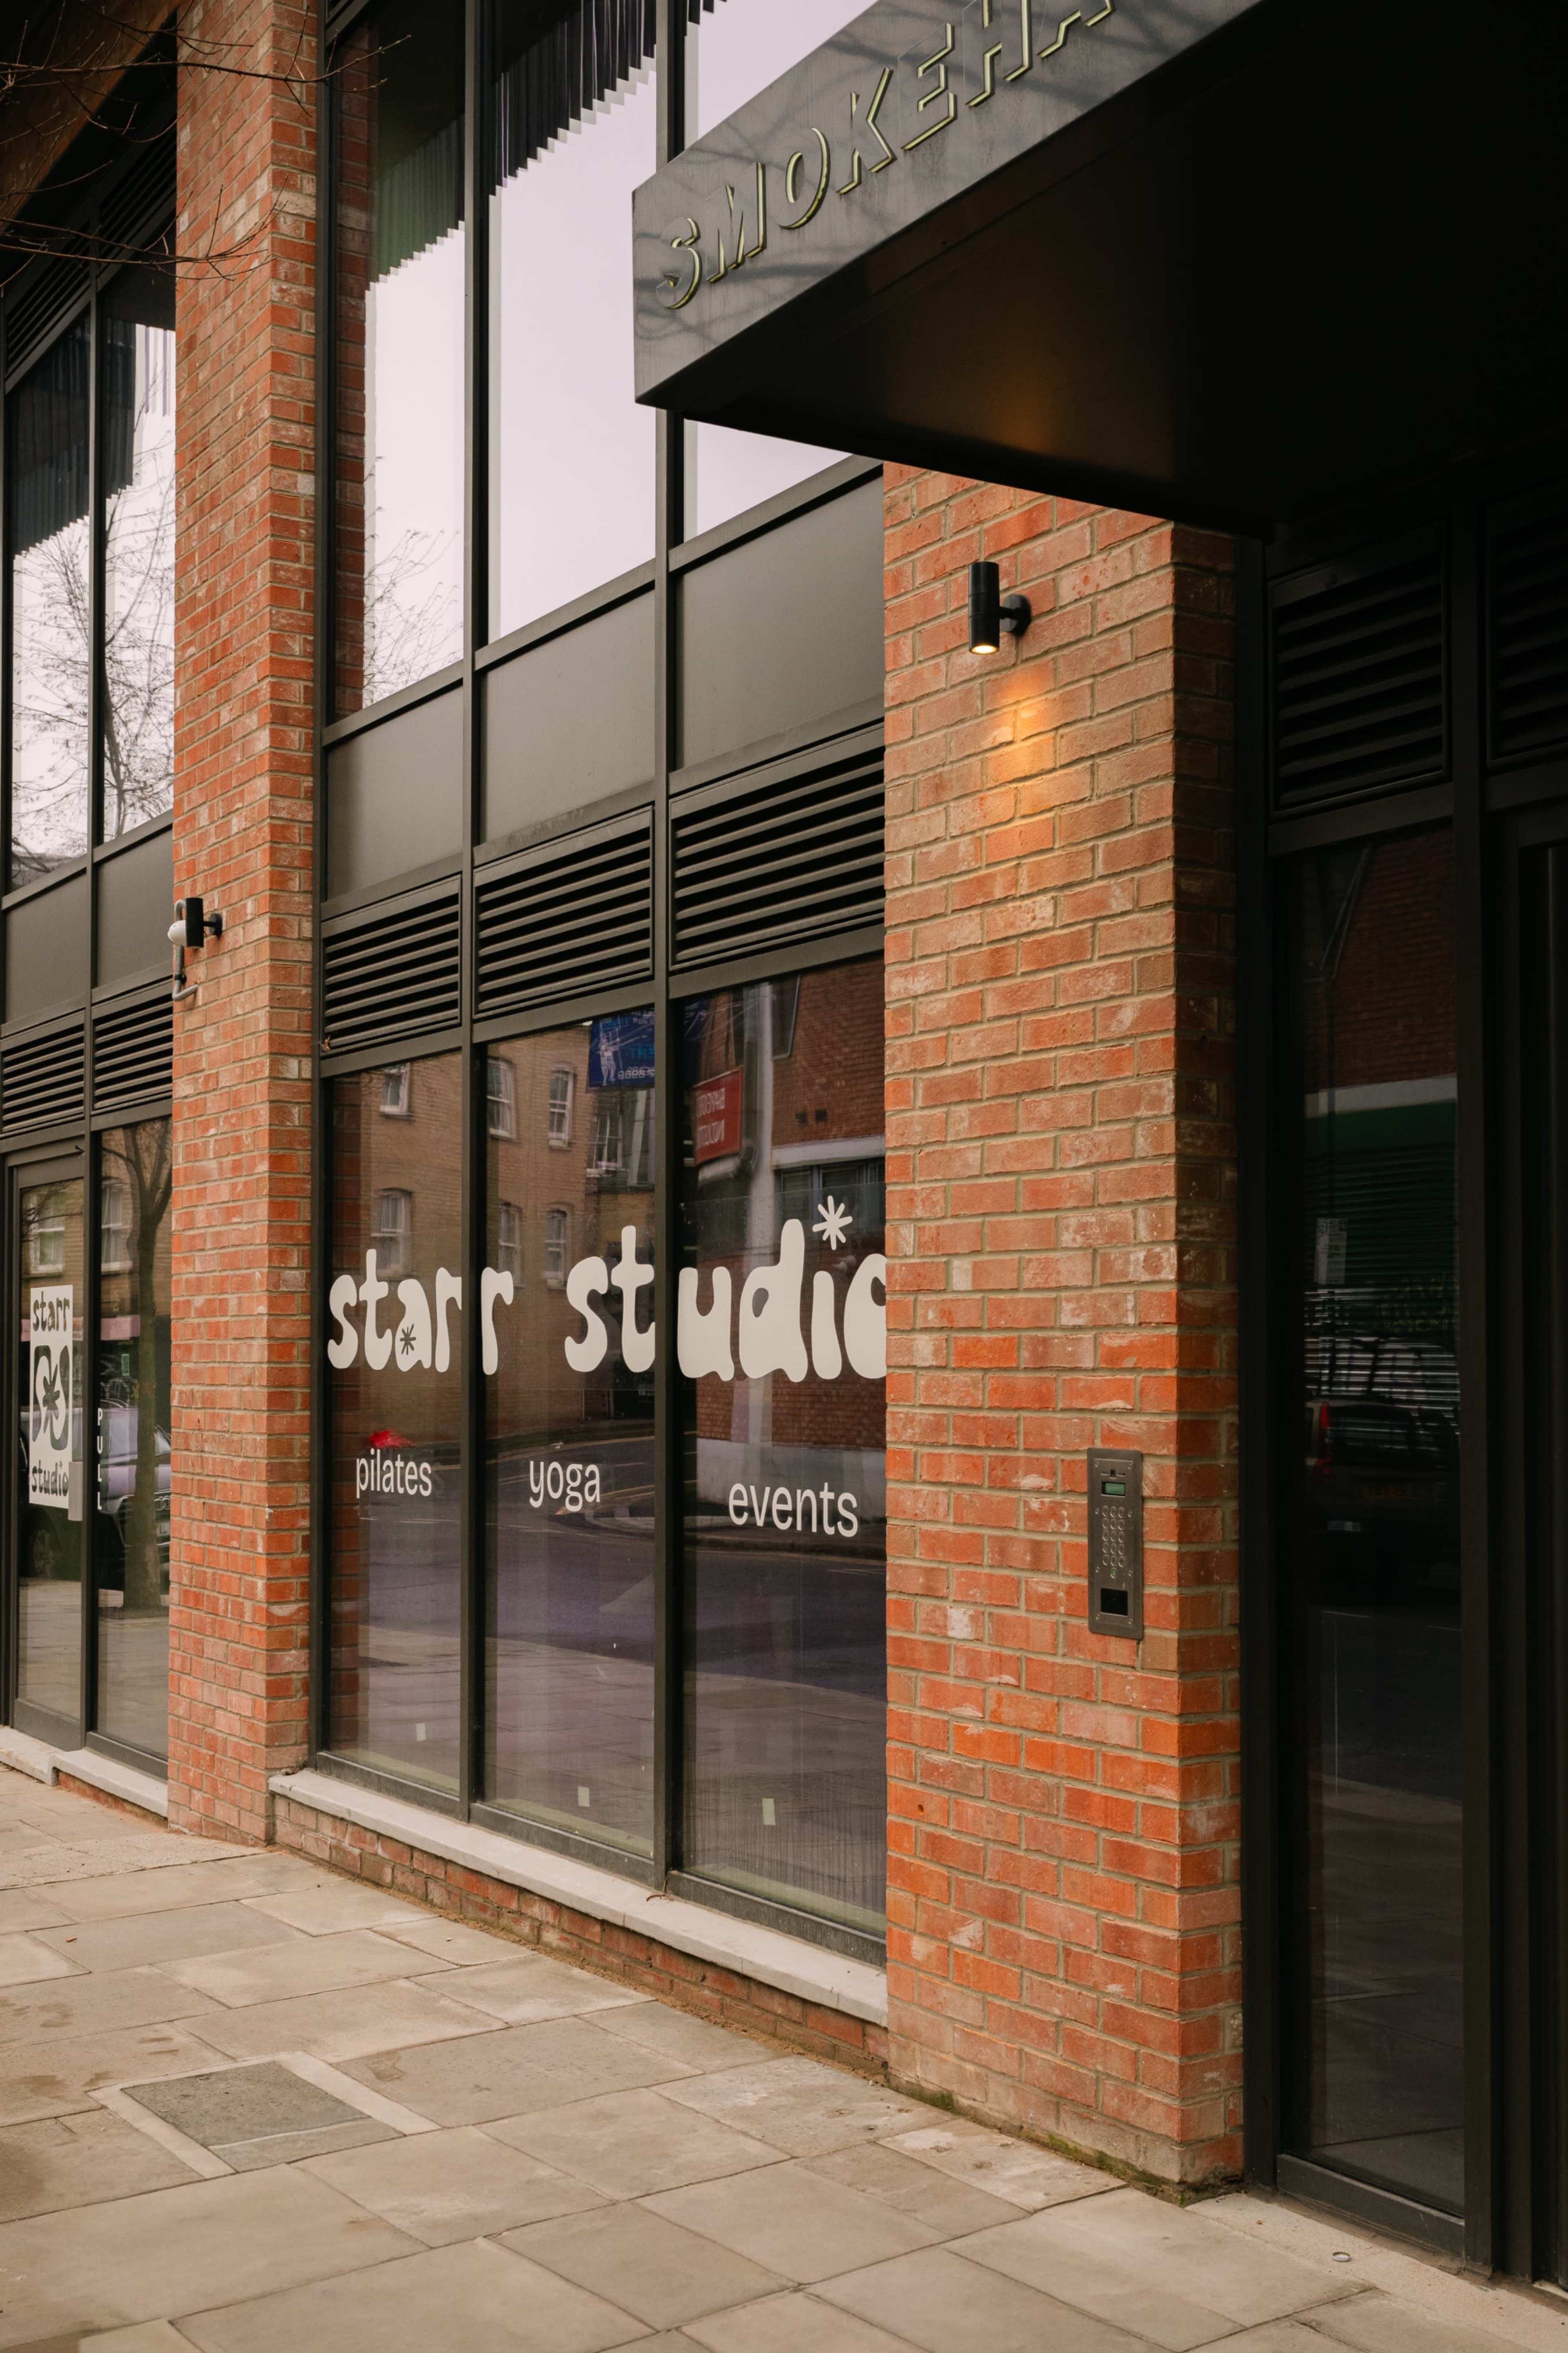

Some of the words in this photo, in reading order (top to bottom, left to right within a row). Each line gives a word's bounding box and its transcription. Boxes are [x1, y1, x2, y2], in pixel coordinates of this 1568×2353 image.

[33, 1291, 70, 1332] starr
[328, 1249, 514, 1375] starr
[31, 1460, 69, 1497] studio
[356, 1448, 432, 1499] pilates
[529, 1461, 601, 1512] yoga
[728, 1482, 858, 1537] events
